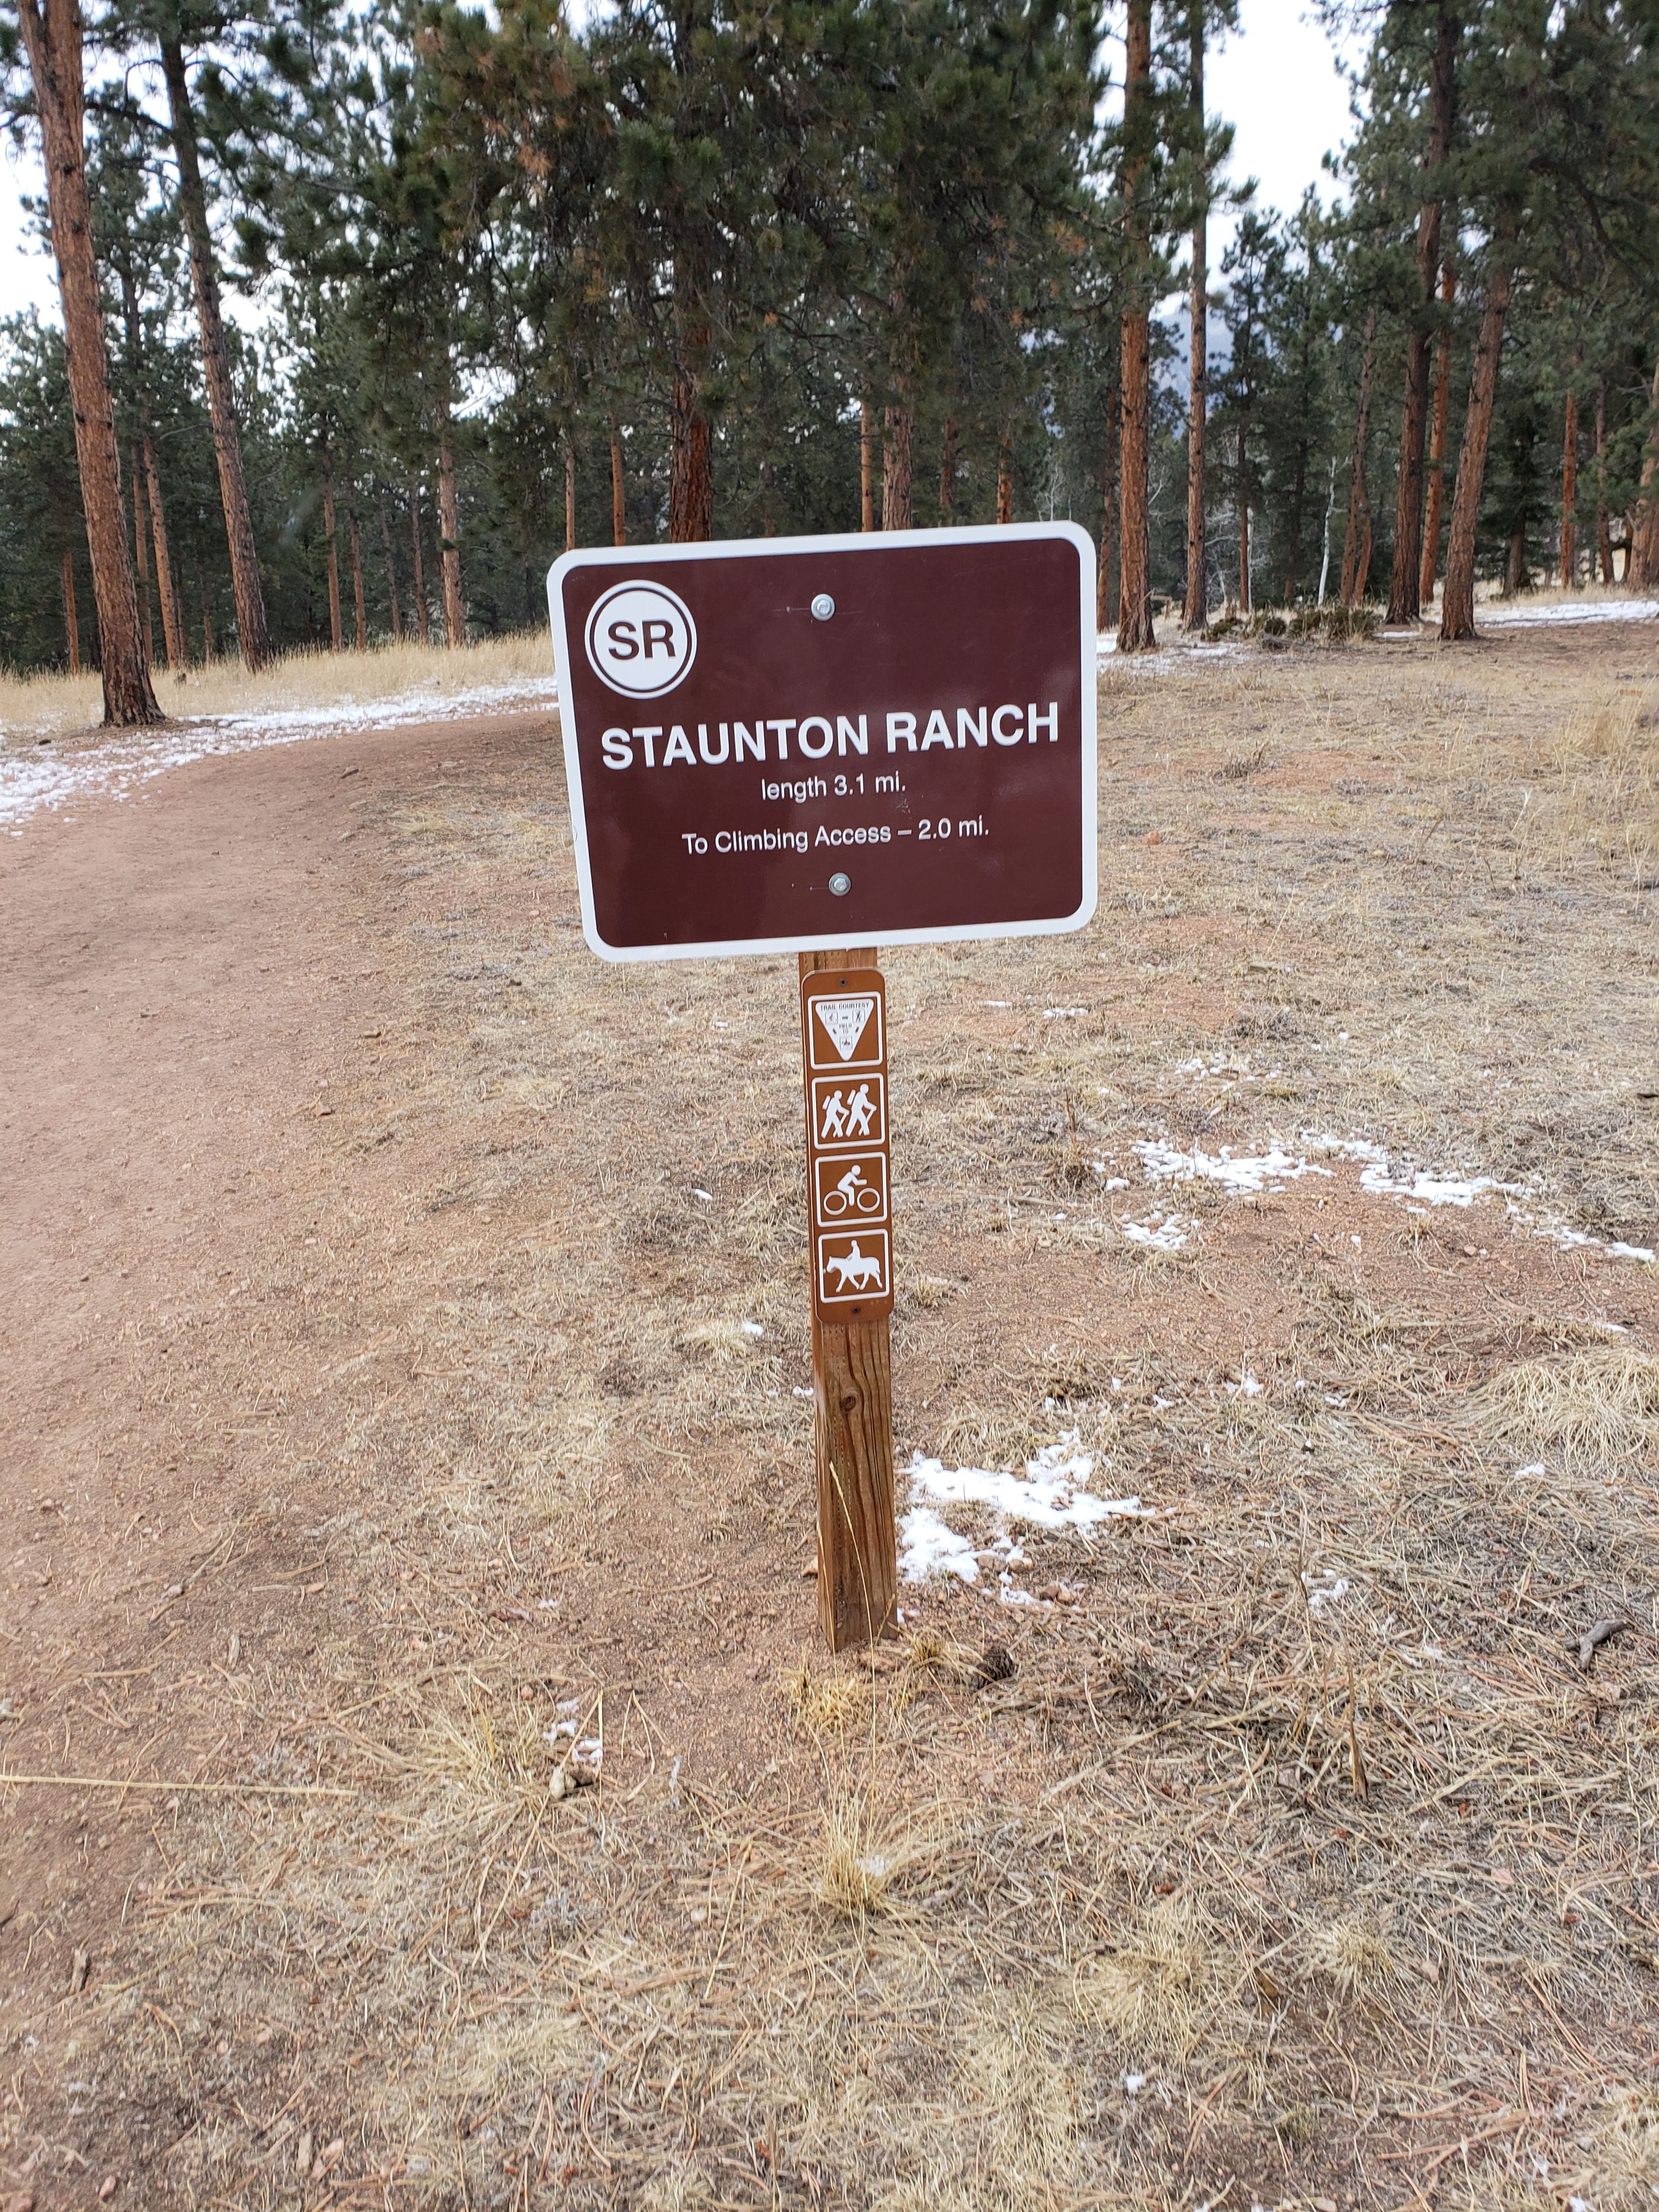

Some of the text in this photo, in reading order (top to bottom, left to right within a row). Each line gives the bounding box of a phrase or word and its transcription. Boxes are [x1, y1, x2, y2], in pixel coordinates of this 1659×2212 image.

[608, 620, 676, 660] SR
[601, 702, 1058, 769] STAUNTON RANCH
[762, 770, 906, 803] length 3.1 mi.
[682, 833, 708, 854] To
[715, 829, 808, 853] Climbing
[814, 825, 891, 847] Access
[918, 818, 951, 840] 2.0
[959, 815, 989, 837] mi.
[839, 1001, 869, 1009] COURTESY
